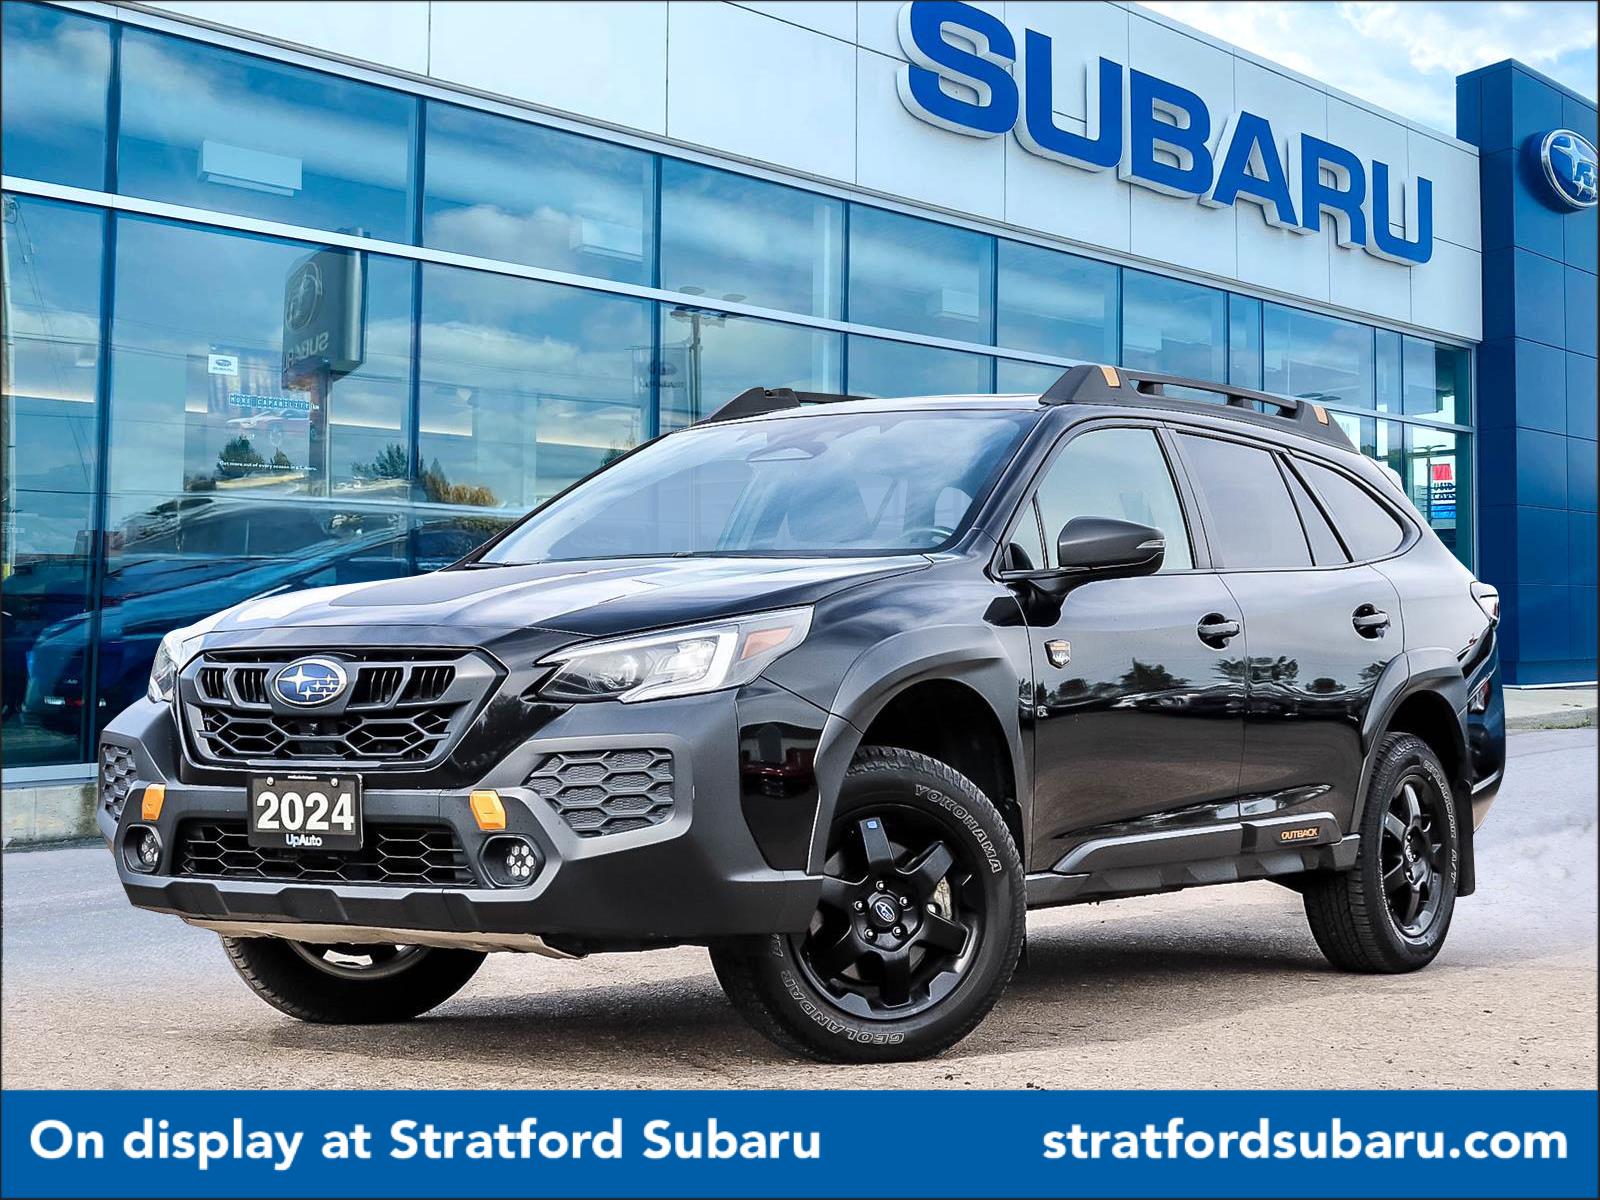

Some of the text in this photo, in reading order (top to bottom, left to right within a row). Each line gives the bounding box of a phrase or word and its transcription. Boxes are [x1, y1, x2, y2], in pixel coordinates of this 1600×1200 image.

[903, 0, 1433, 265] SUBARU
[256, 791, 355, 831] 2024
[285, 833, 323, 847] UpAuto
[914, 783, 1002, 874] YOKOHAMA
[1281, 828, 1318, 839] OUTBACK
[780, 969, 905, 1045] GEOLANDAR
